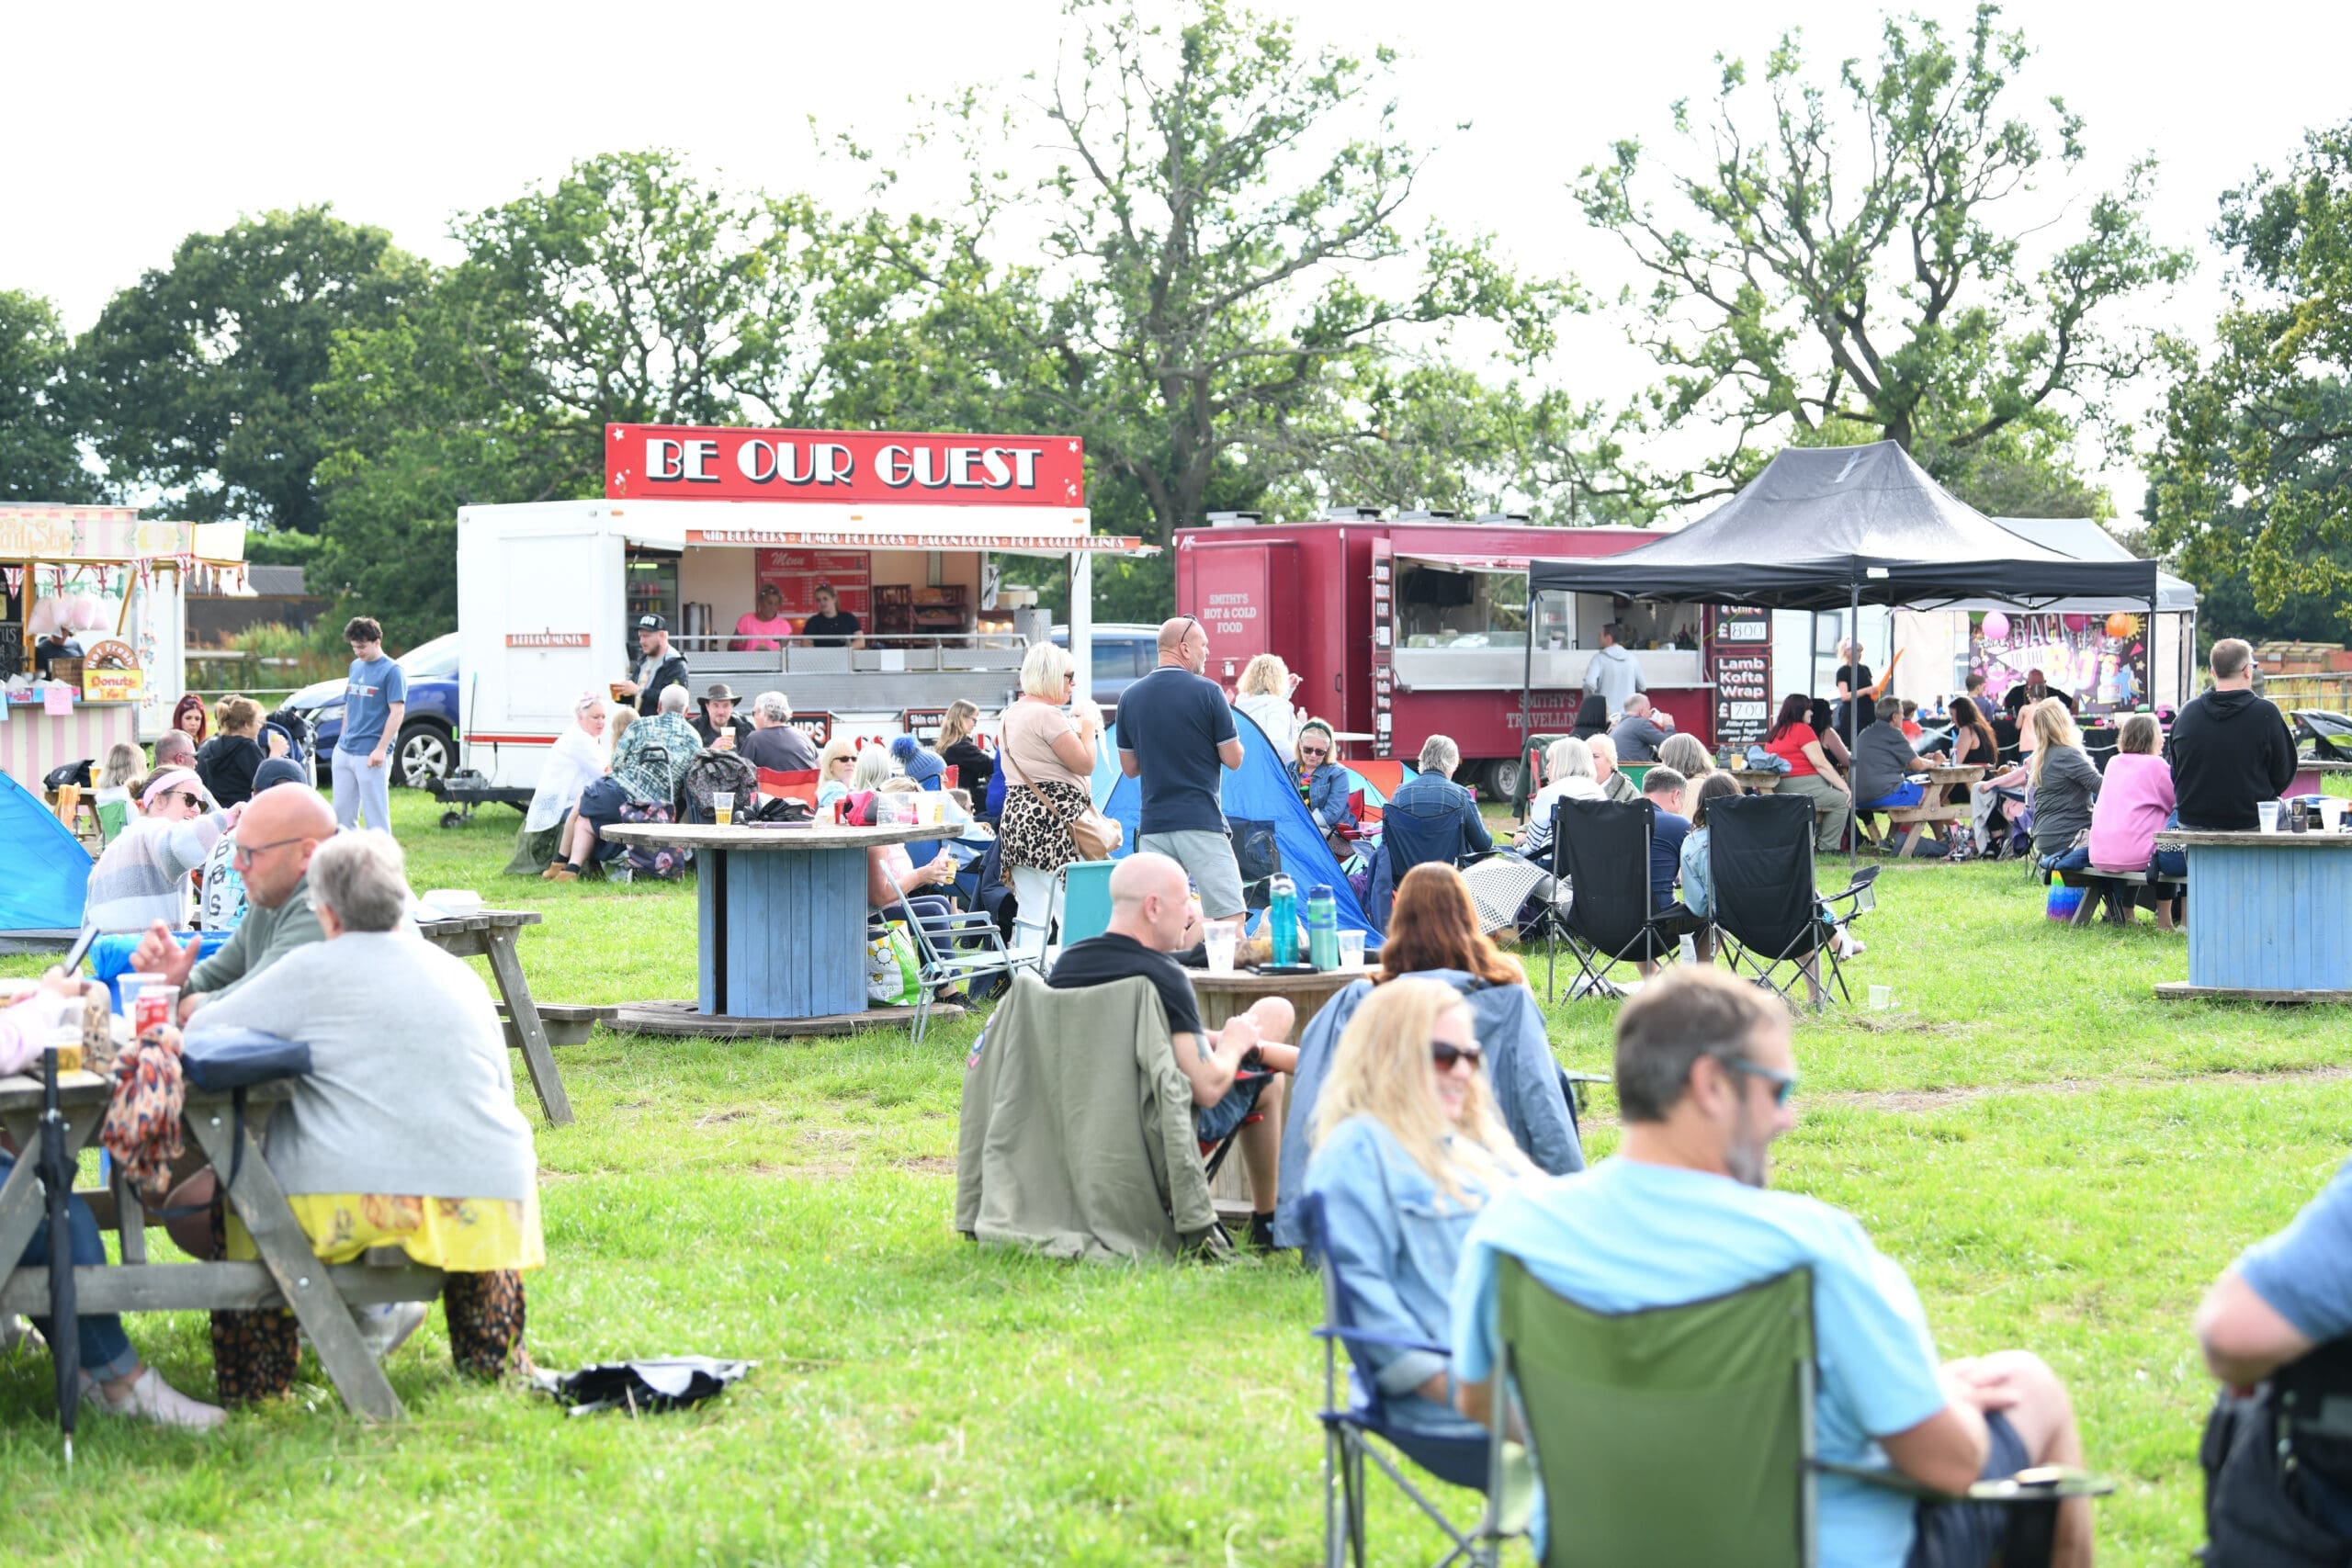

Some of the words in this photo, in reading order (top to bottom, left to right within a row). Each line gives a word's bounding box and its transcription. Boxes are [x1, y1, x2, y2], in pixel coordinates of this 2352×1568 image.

[646, 438, 721, 483] BE
[737, 439, 853, 487] OUR
[874, 445, 1043, 490] GUEST
[727, 531, 786, 543] BURGERS
[798, 533, 840, 544] JUMBO
[844, 534, 869, 545] HOT
[873, 535, 906, 546] DOGS
[918, 536, 958, 547] BACON
[961, 536, 1000, 547] ROLLS
[1011, 536, 1034, 547] HOT
[1048, 537, 1078, 547] COLD
[1081, 537, 1125, 548] DRINKS
[771, 552, 805, 566] Menu
[1209, 593, 1249, 604] SMITHY'S
[1204, 608, 1222, 619] HOT
[1223, 608, 1230, 618] &
[1232, 607, 1257, 618] COLD
[1216, 622, 1243, 633] FOOD
[1718, 623, 1728, 638] £
[1719, 657, 1766, 671] Lamb
[2010, 653, 2022, 667] TO
[90, 675, 137, 687] Donuts
[1720, 671, 1765, 684] Kofta
[1720, 685, 1766, 700] Wrap
[1718, 702, 1729, 718] £
[910, 714, 926, 726] Skin
[926, 716, 937, 726] on
